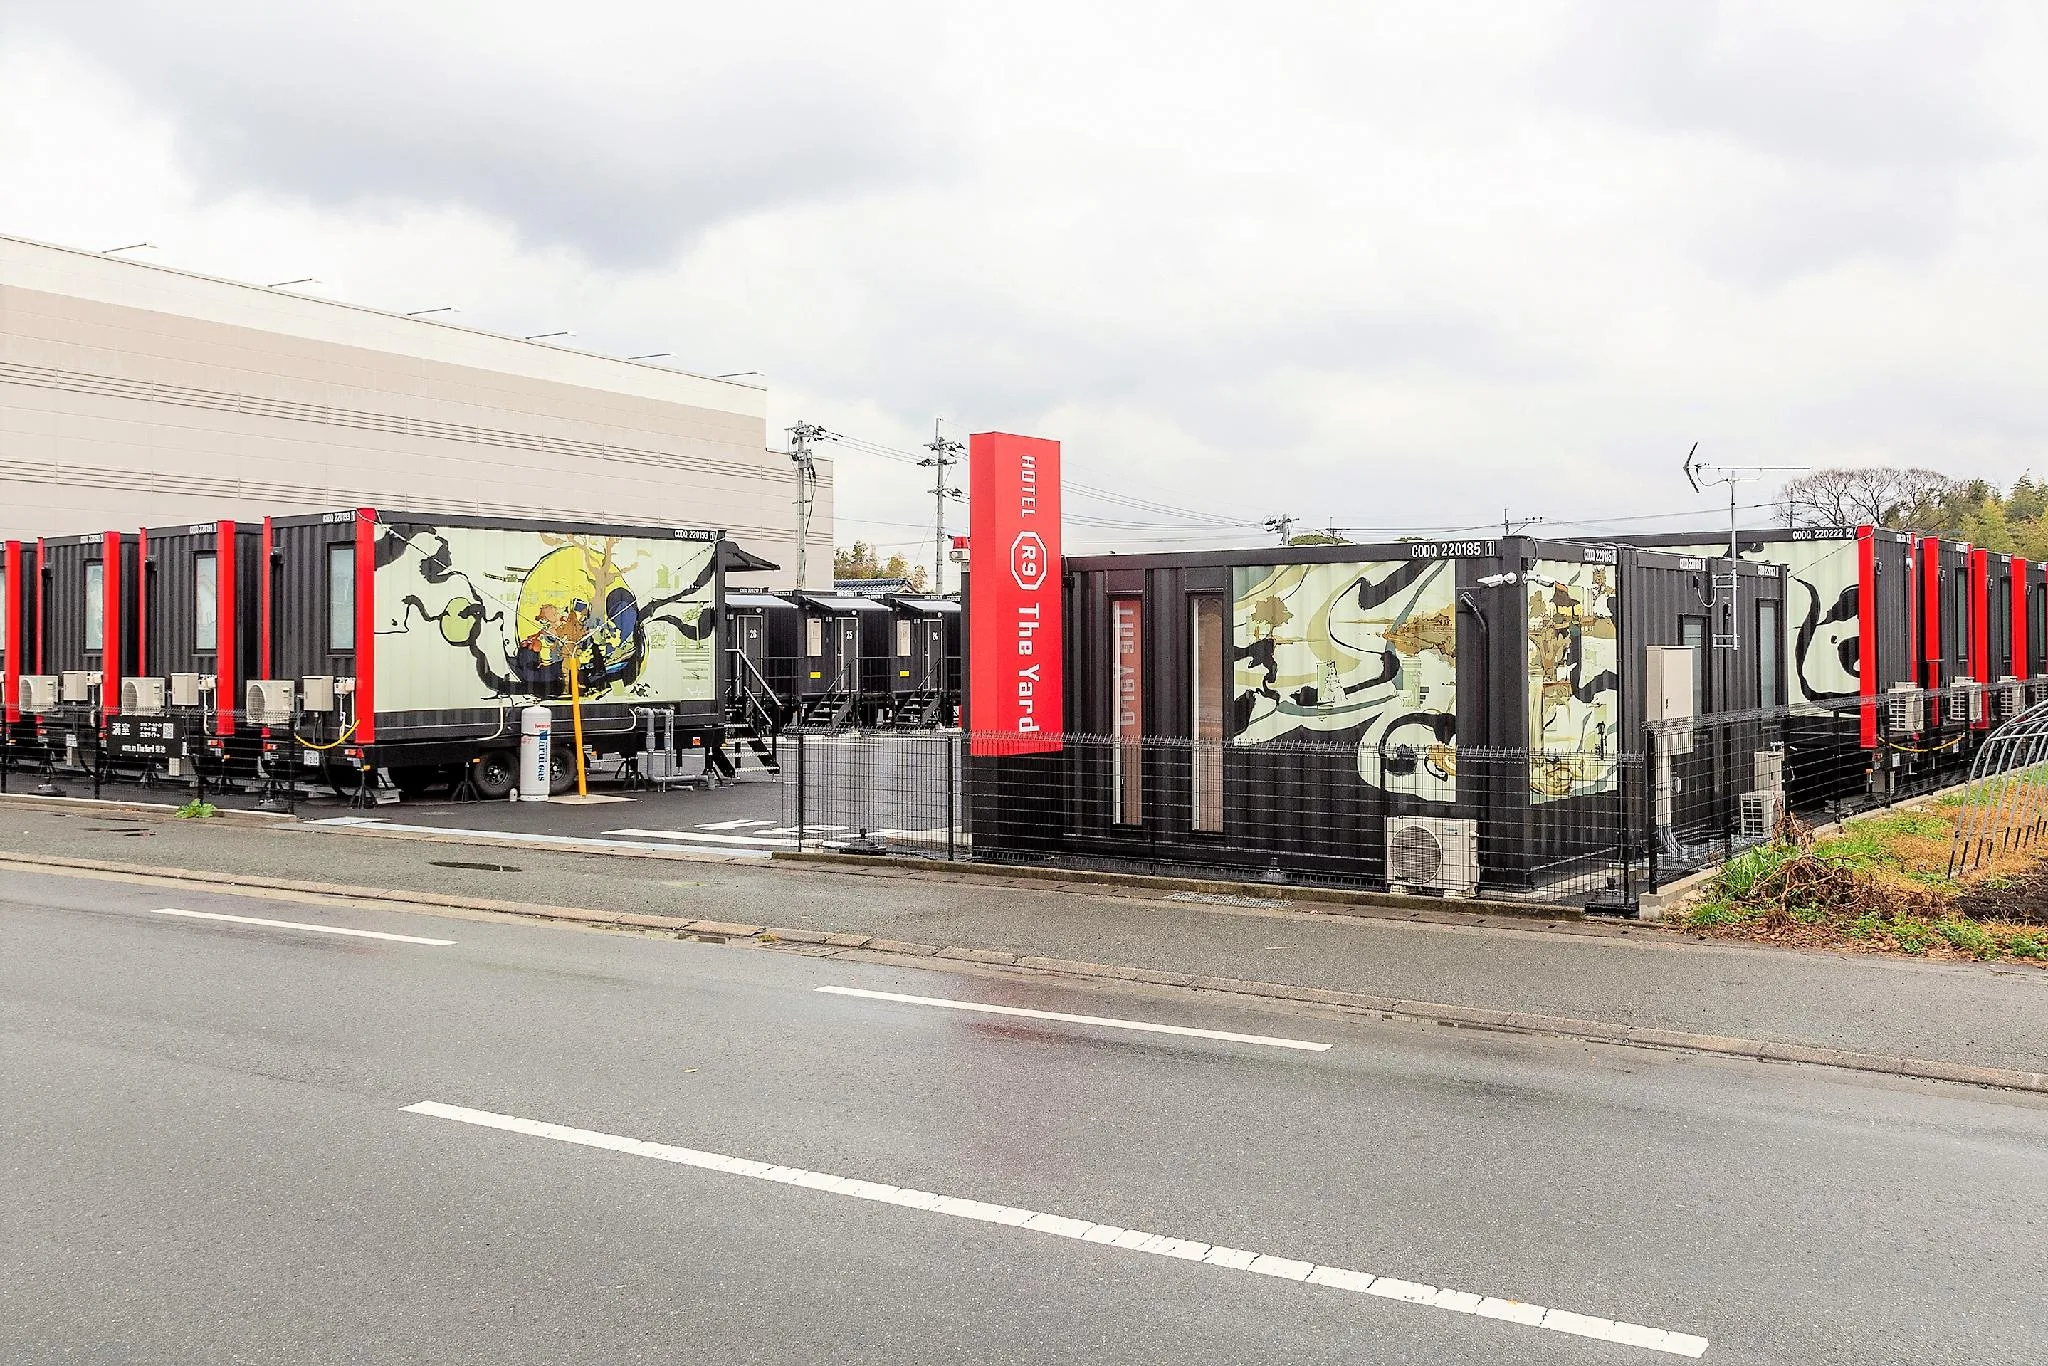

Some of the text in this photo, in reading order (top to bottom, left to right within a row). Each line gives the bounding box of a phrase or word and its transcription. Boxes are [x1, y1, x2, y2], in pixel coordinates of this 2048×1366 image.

[1021, 455, 1036, 518] HOTEL
[1021, 545, 1037, 577] R9
[1441, 541, 1481, 557] 220185
[1018, 602, 1040, 733] The Yard
